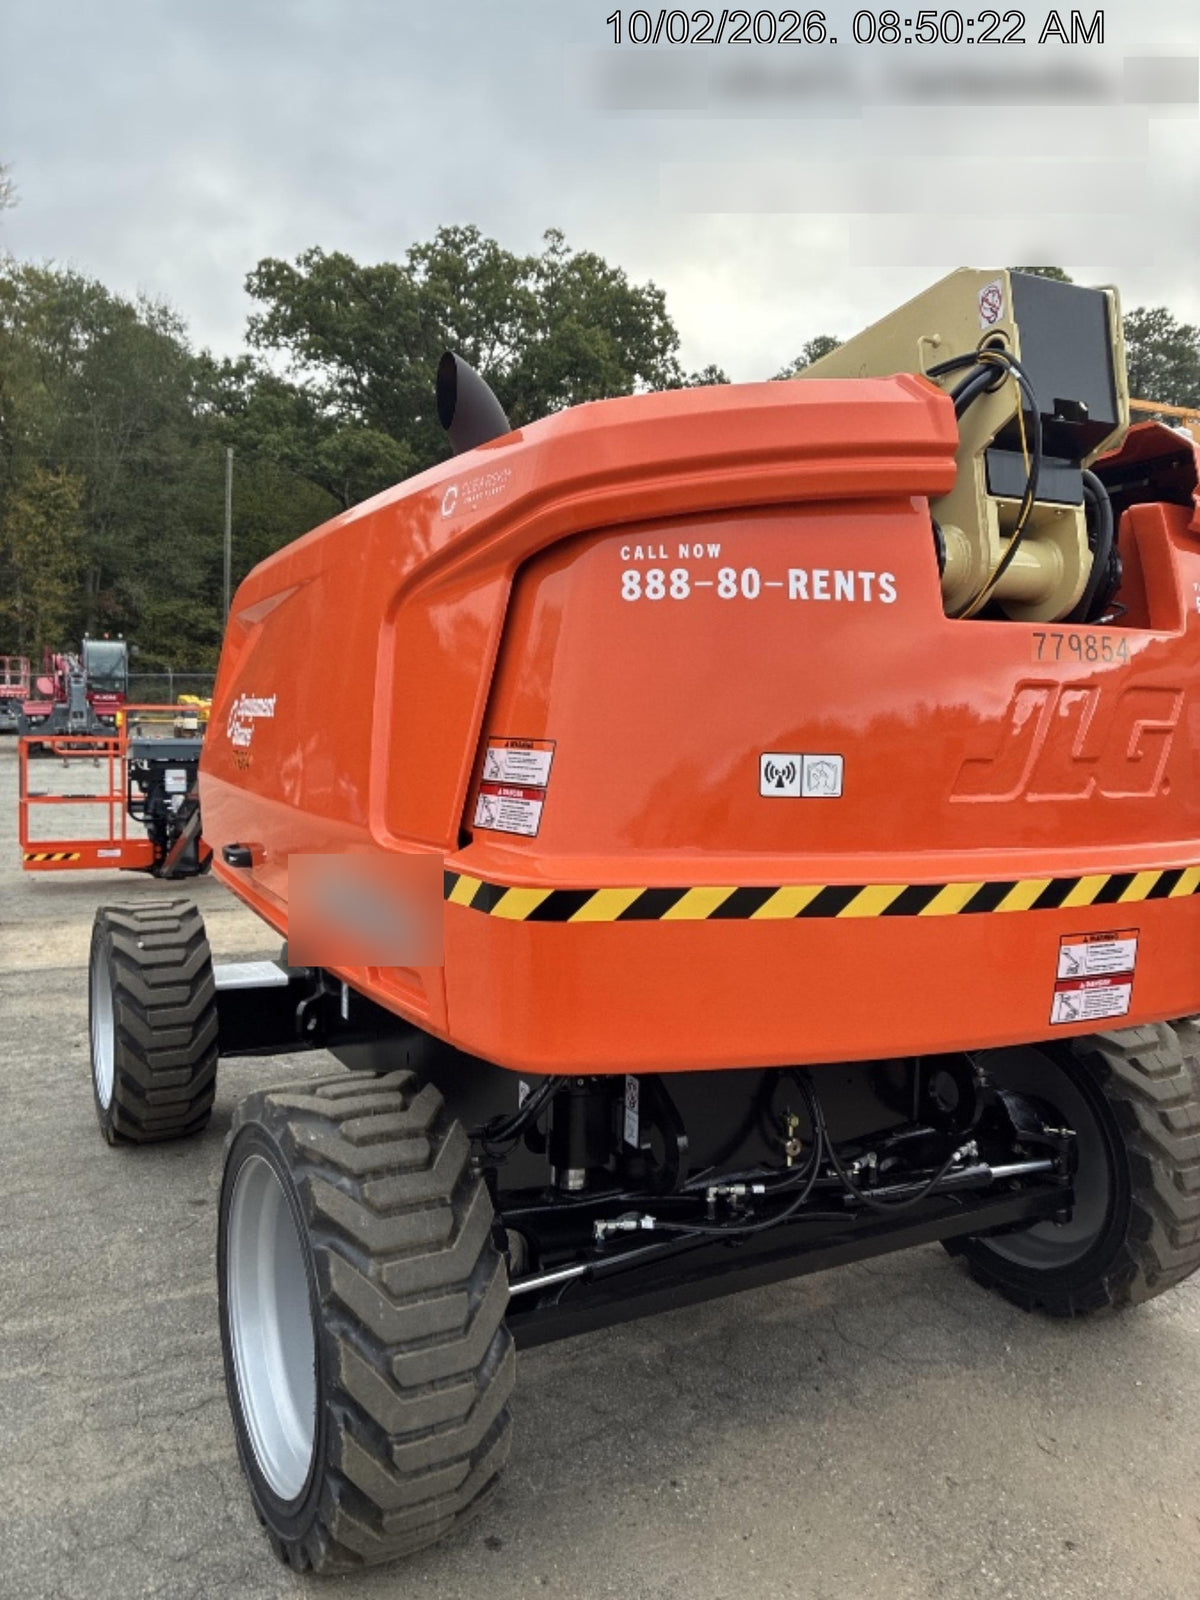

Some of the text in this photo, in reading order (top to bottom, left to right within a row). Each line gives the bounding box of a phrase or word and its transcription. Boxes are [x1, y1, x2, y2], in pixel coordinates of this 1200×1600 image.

[620, 543, 721, 561] CALL NOW
[621, 567, 898, 604] 888-80-RENTS
[1032, 632, 1129, 663] 779854
[949, 678, 1186, 804] JLG
